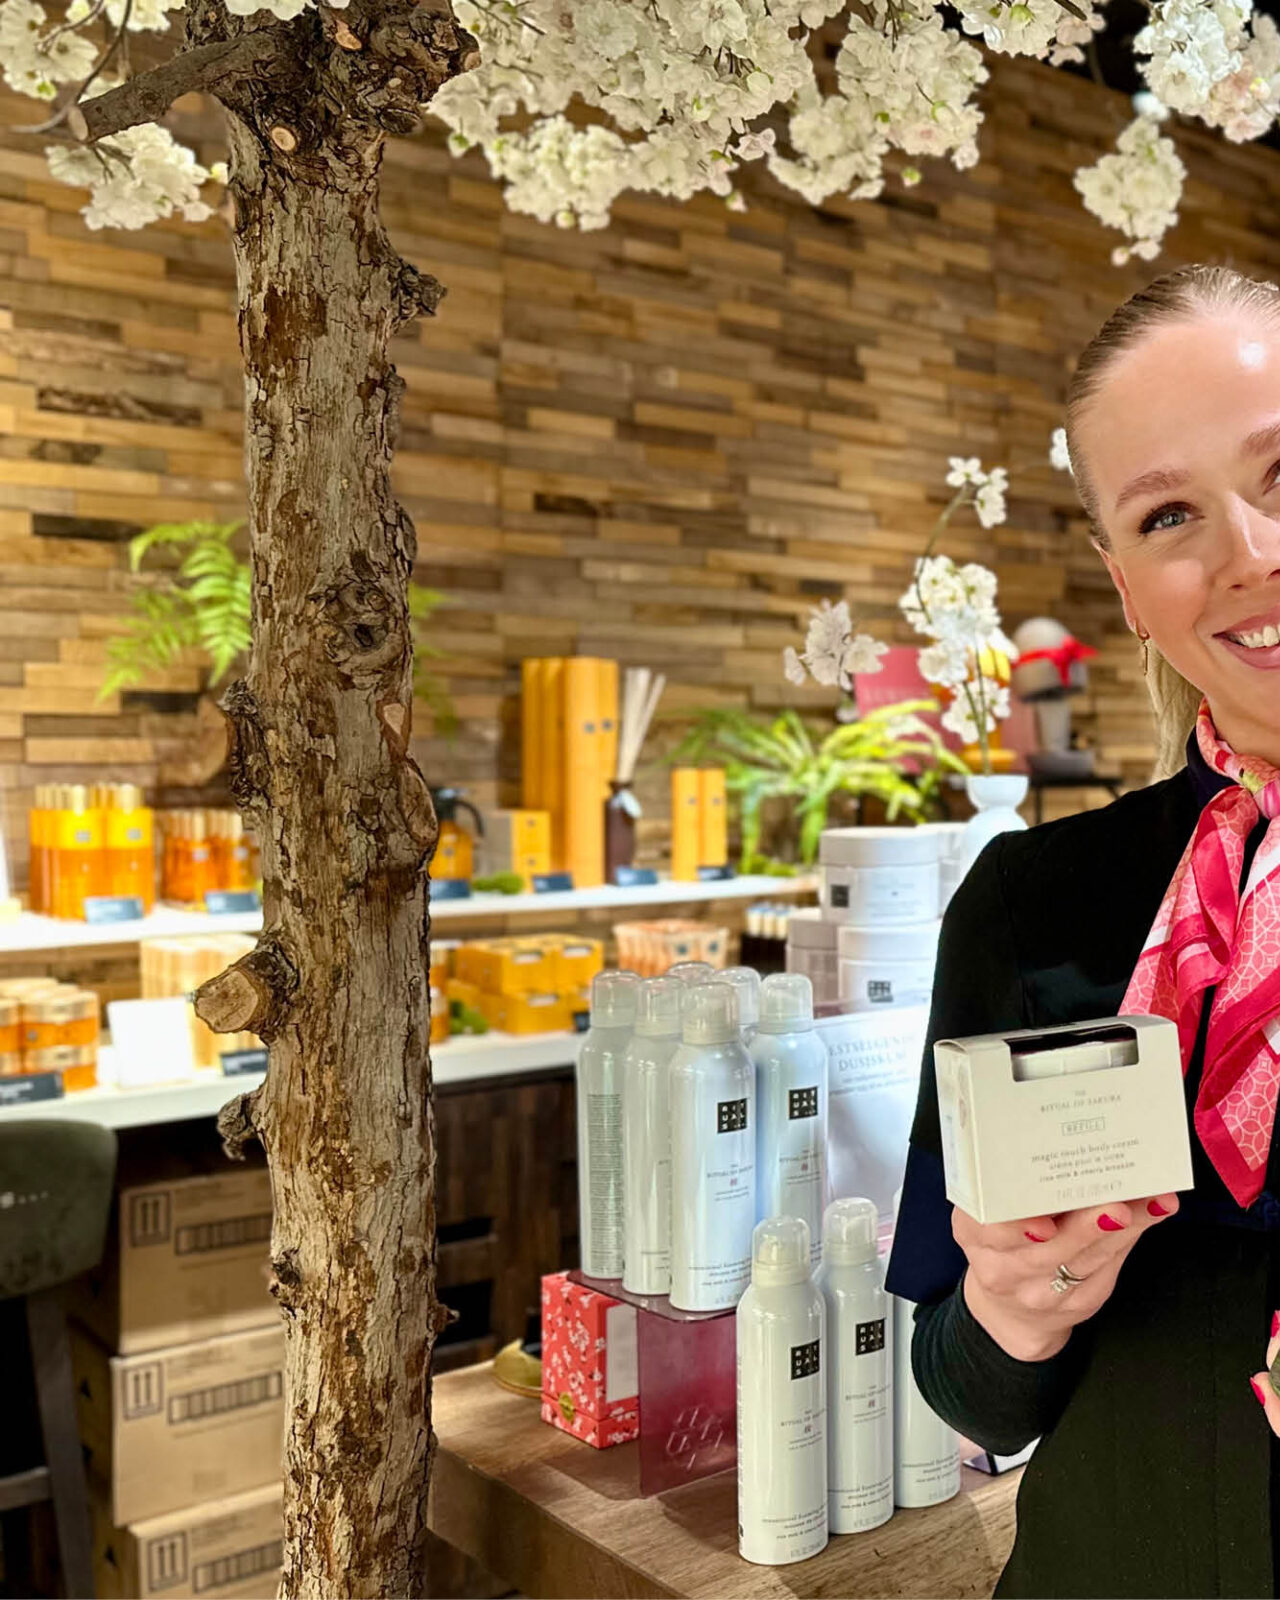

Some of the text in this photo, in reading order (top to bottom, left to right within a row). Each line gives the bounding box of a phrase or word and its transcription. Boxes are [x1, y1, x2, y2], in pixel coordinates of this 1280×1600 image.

[1031, 1151, 1059, 1163] magic
[1088, 1142, 1110, 1153] body
[1111, 1138, 1140, 1149] cream
